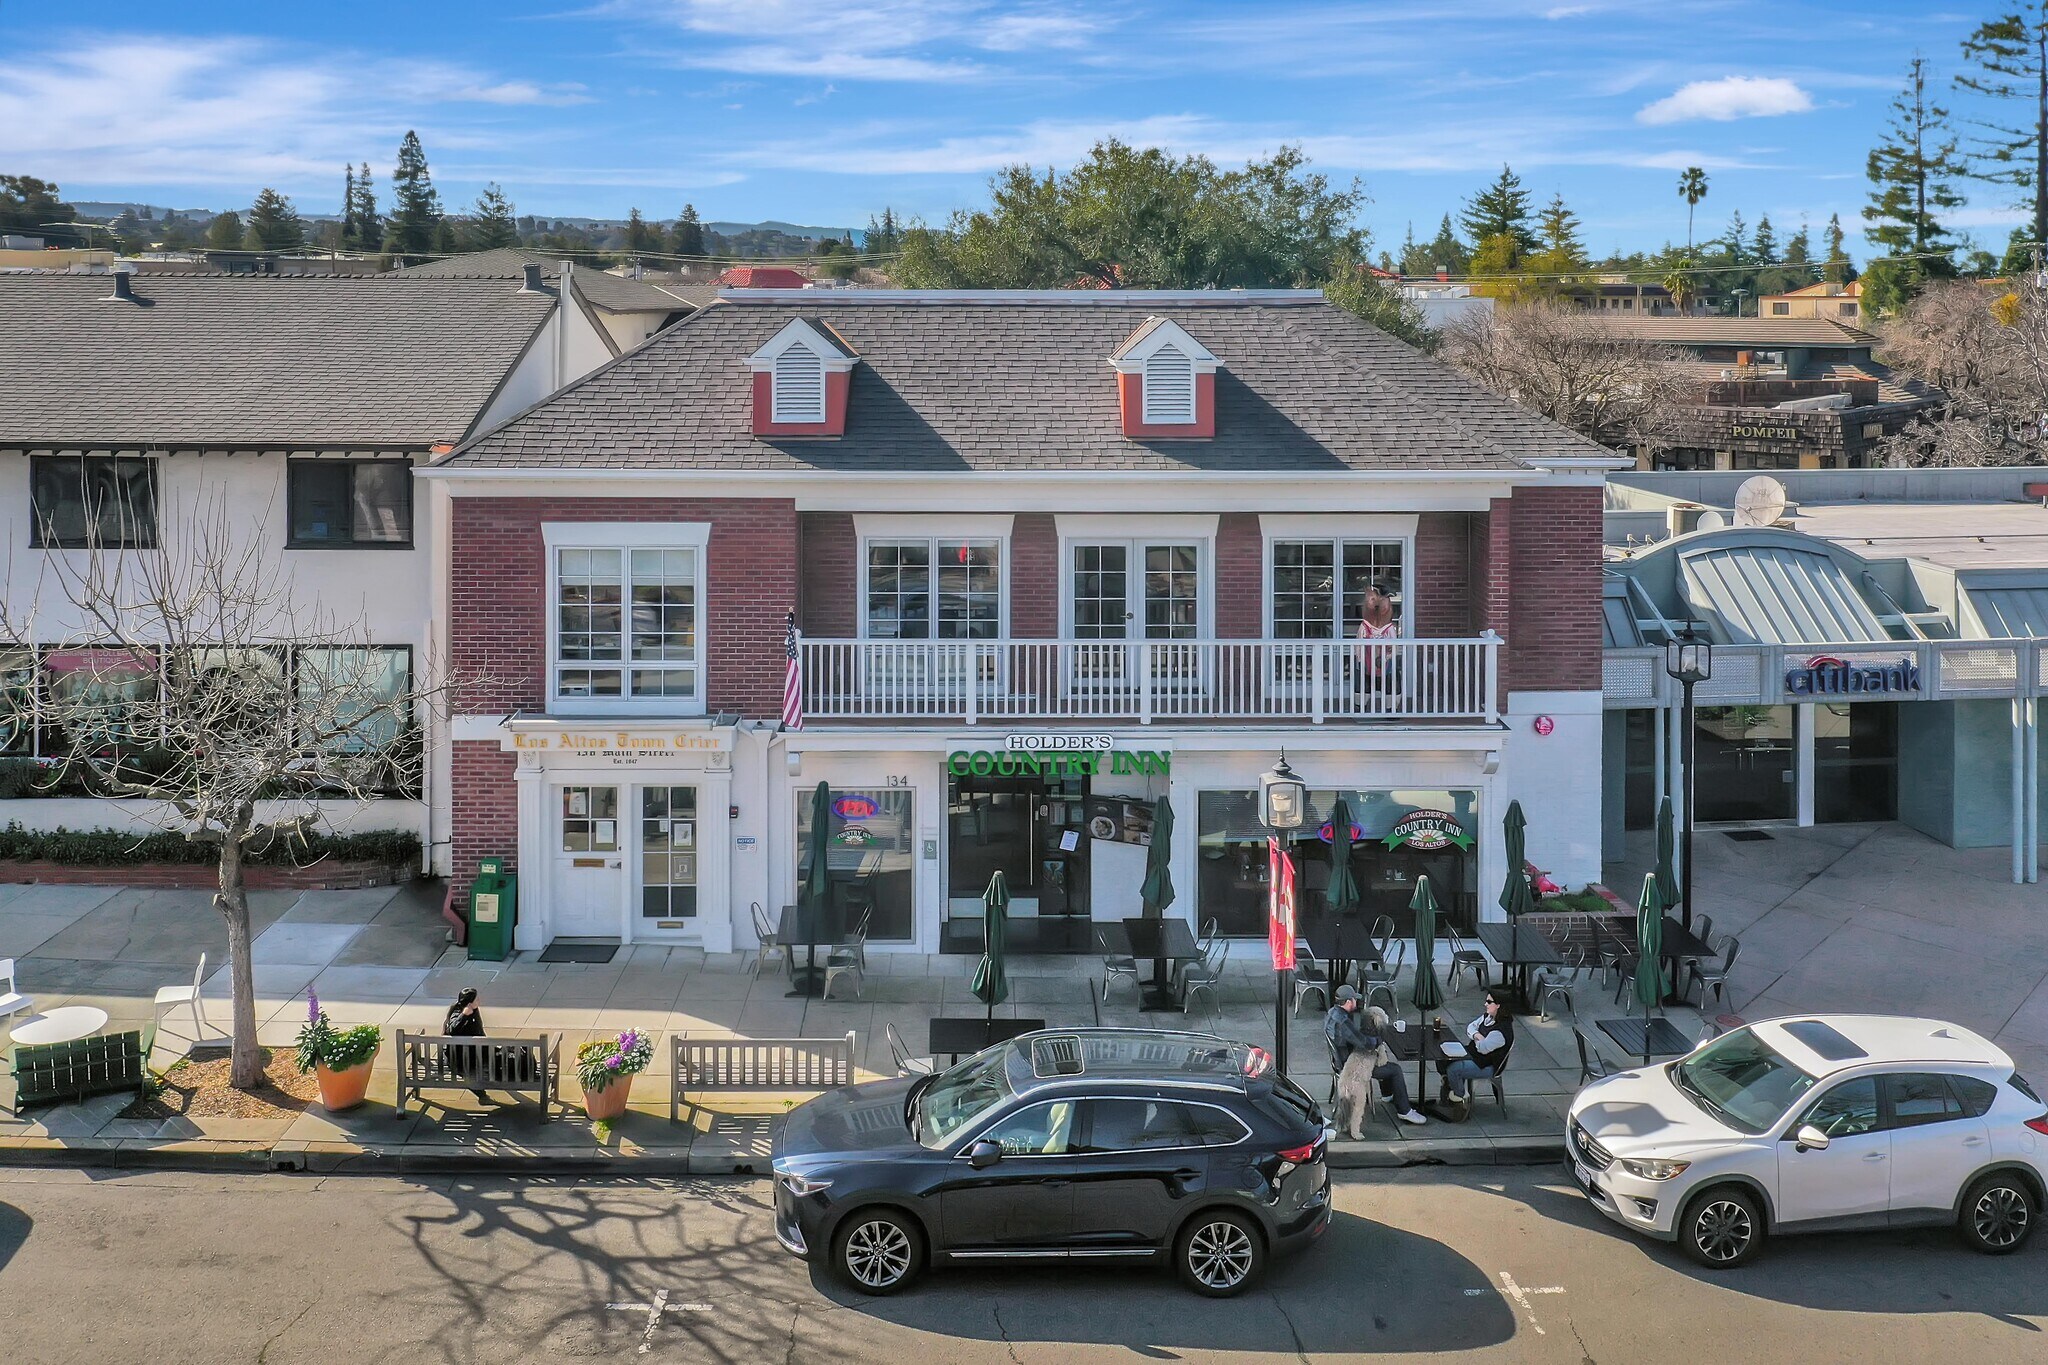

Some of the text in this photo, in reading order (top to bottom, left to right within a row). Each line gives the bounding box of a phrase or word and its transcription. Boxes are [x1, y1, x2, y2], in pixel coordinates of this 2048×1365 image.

[1732, 425, 1797, 440] POMPEII
[1786, 655, 1923, 696] citibank
[514, 732, 720, 749] Los Altos Town Crier
[1009, 736, 1111, 749] HOLDER'S
[948, 750, 1171, 776] COUNTRY INN
[886, 775, 908, 787] 134
[836, 800, 875, 817] OPEN
[1409, 810, 1448, 821] HOLDER'S
[1321, 825, 1361, 841] ON
[1394, 819, 1463, 838] COUNTRY INN
[1411, 839, 1446, 848] LOS ALTOS
